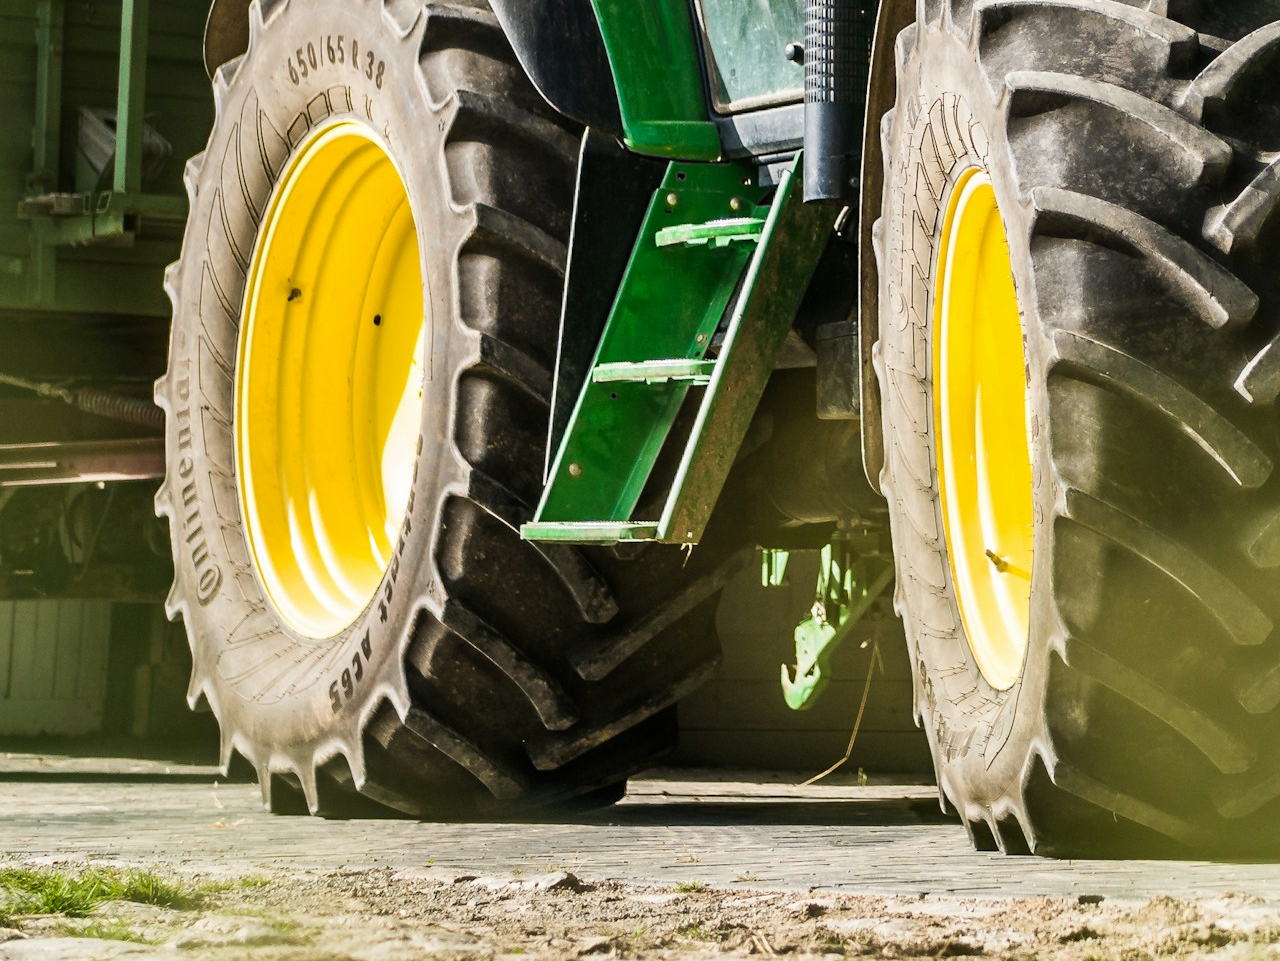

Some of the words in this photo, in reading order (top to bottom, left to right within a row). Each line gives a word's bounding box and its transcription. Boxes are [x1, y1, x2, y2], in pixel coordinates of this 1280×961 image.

[287, 35, 346, 86] 650/65
[352, 39, 359, 71] R
[365, 50, 385, 90] 38
[175, 356, 224, 608] Continental
[328, 626, 373, 715] AC65
